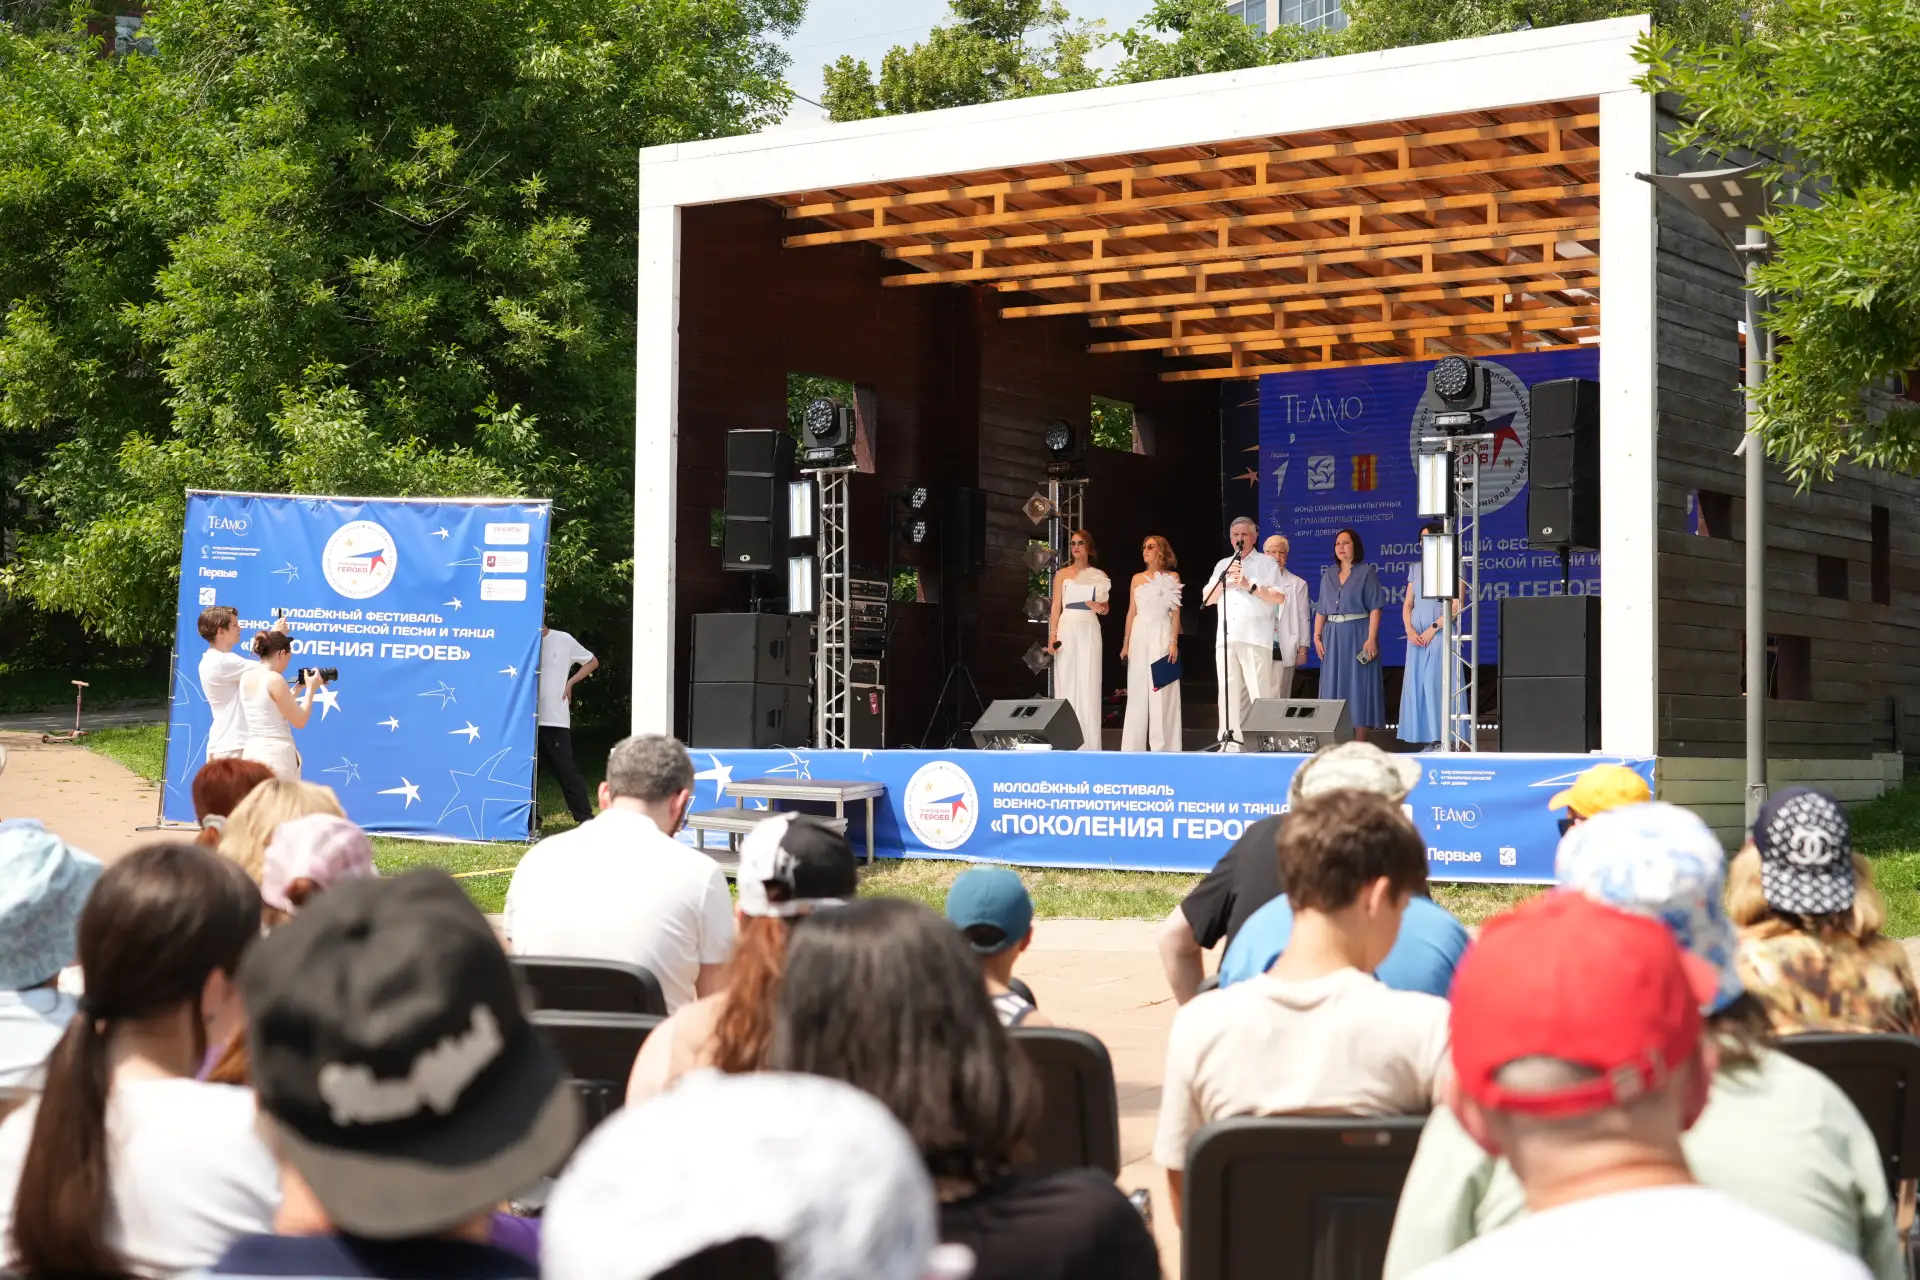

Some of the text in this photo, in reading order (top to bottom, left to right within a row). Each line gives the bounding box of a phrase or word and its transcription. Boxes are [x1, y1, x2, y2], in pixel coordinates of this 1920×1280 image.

[1314, 503, 1357, 512] СОХРАНЕНИЯ
[1357, 500, 1402, 509] КУЛЬТУРНЫХ
[1300, 515, 1354, 525] ГУМАНИТАРНЫХ
[1354, 511, 1394, 523] ЦЕННОСТЕЙ
[199, 566, 238, 580] Первые
[1518, 578, 1600, 598] ГЕРОЕ
[365, 611, 443, 623] ФЕСТИВАЛЬ
[393, 626, 436, 637] ПЕСНИ
[440, 627, 448, 637] И
[452, 628, 494, 639] ТАНЦА
[380, 643, 471, 661] ГЕРОЕВ»
[993, 781, 1175, 796] МОЛОДЁЖНЫЙ ФЕСТИВАЛЬ
[993, 798, 1174, 812] ВОЕННО-ПАТРИОТИЧЕСКОЙ
[1178, 801, 1225, 813] ПЕСНИ
[1229, 802, 1238, 814] И
[990, 814, 1164, 838] «ПОКОЛЕНИЯ
[1427, 847, 1482, 865] Первые
